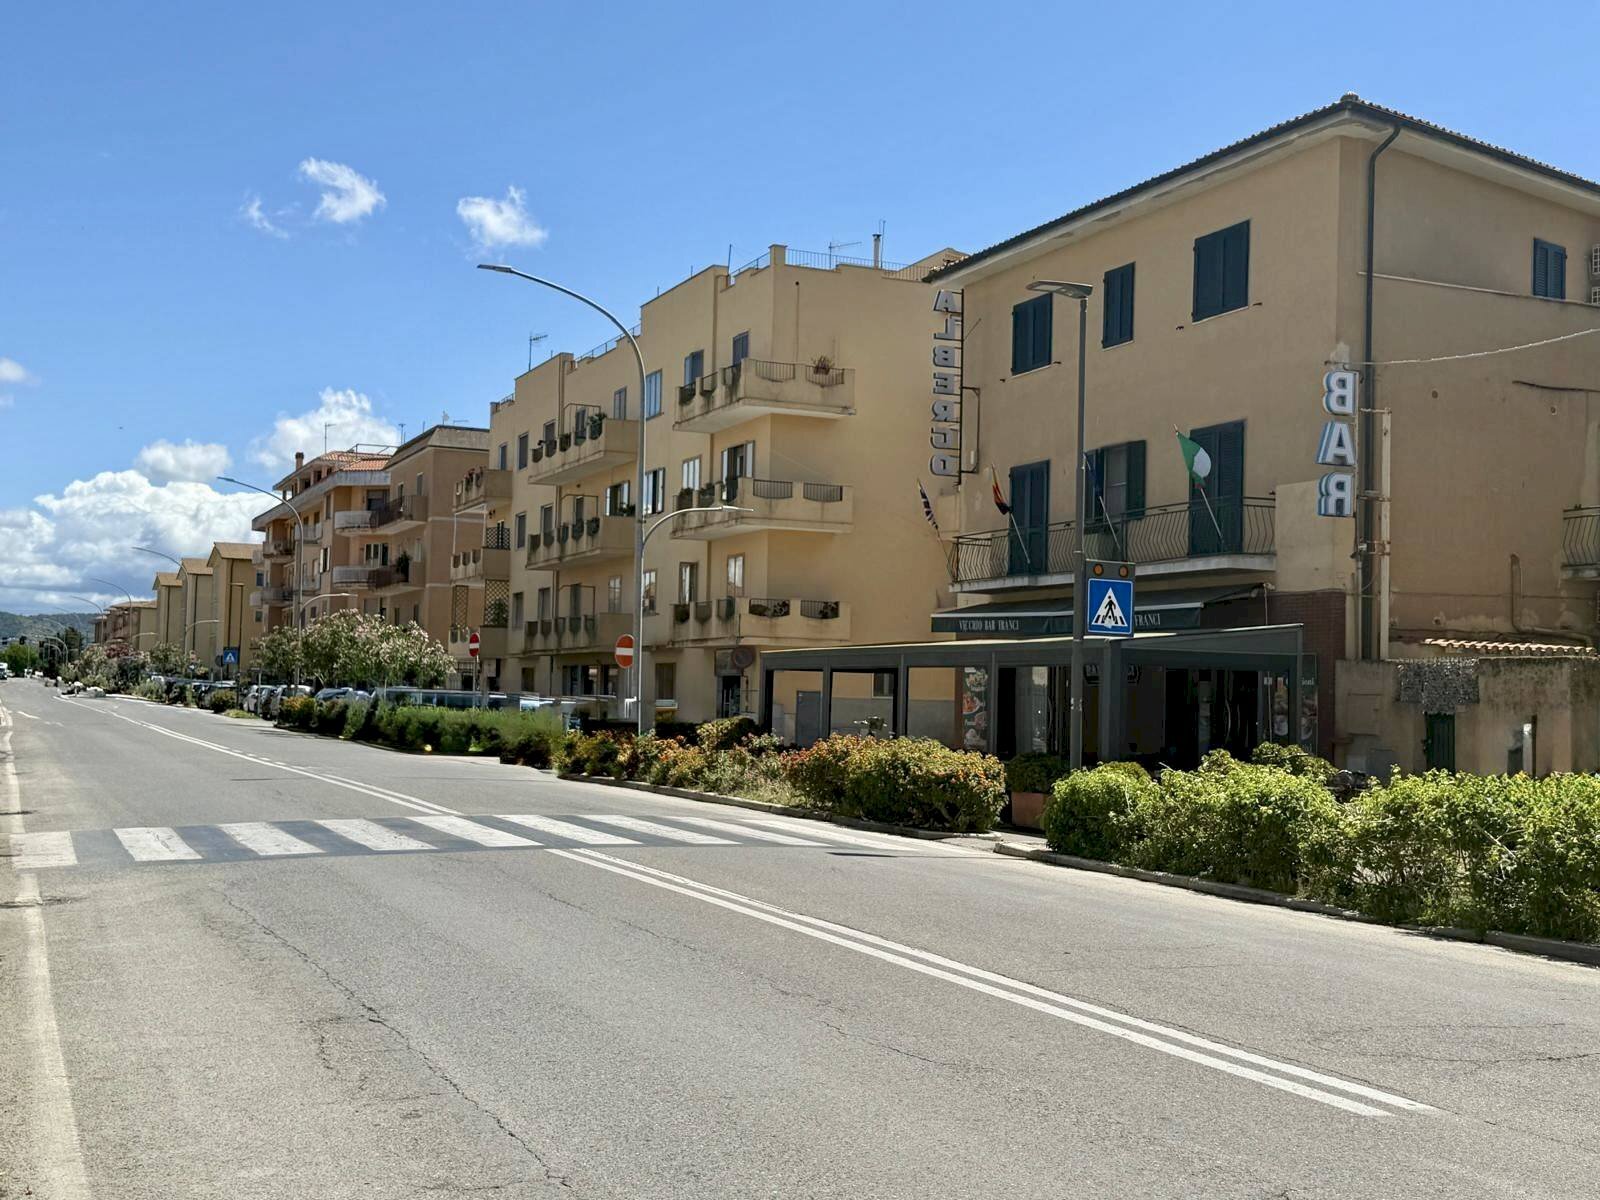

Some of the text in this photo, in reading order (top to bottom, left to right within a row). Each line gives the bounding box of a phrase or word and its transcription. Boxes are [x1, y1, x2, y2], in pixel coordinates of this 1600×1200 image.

[959, 618, 1020, 631] VECCHIO BAR FRANCI
